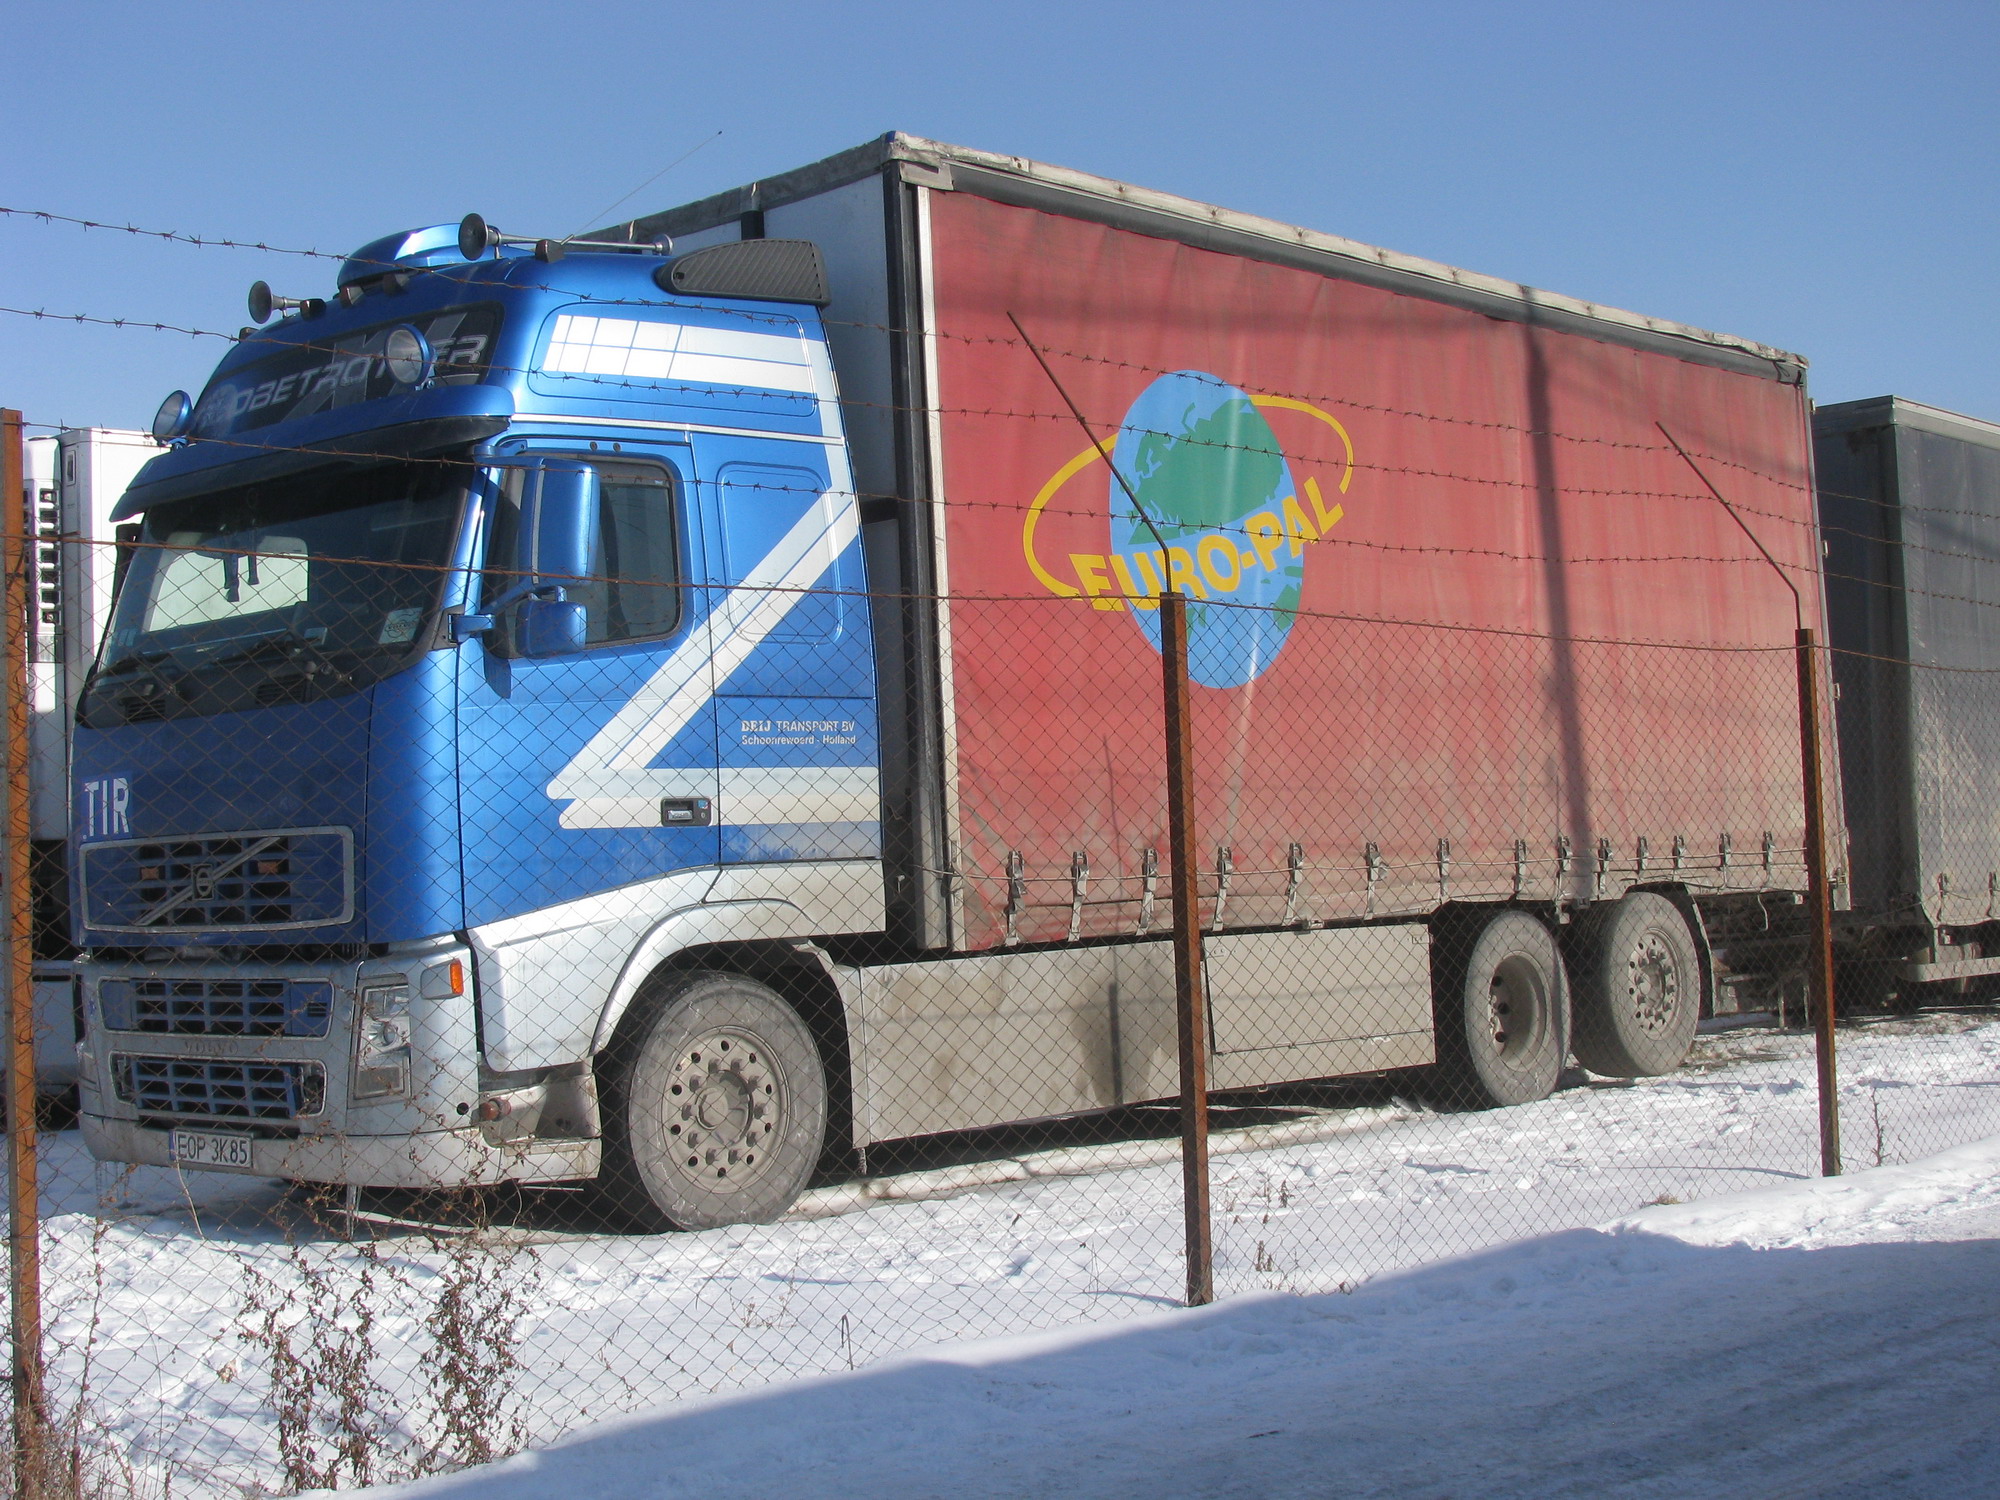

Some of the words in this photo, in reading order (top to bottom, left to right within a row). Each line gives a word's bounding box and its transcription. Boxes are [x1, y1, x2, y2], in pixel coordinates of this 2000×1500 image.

[196, 334, 488, 428] OBETROER
[1068, 476, 1345, 612] EURO-PAL
[776, 720, 838, 732] TRANSPORT
[841, 720, 855, 732] BV
[822, 734, 856, 745] Holland
[84, 777, 130, 838] TIR
[177, 1134, 206, 1160] EOP
[211, 1138, 248, 1165] 3K85
